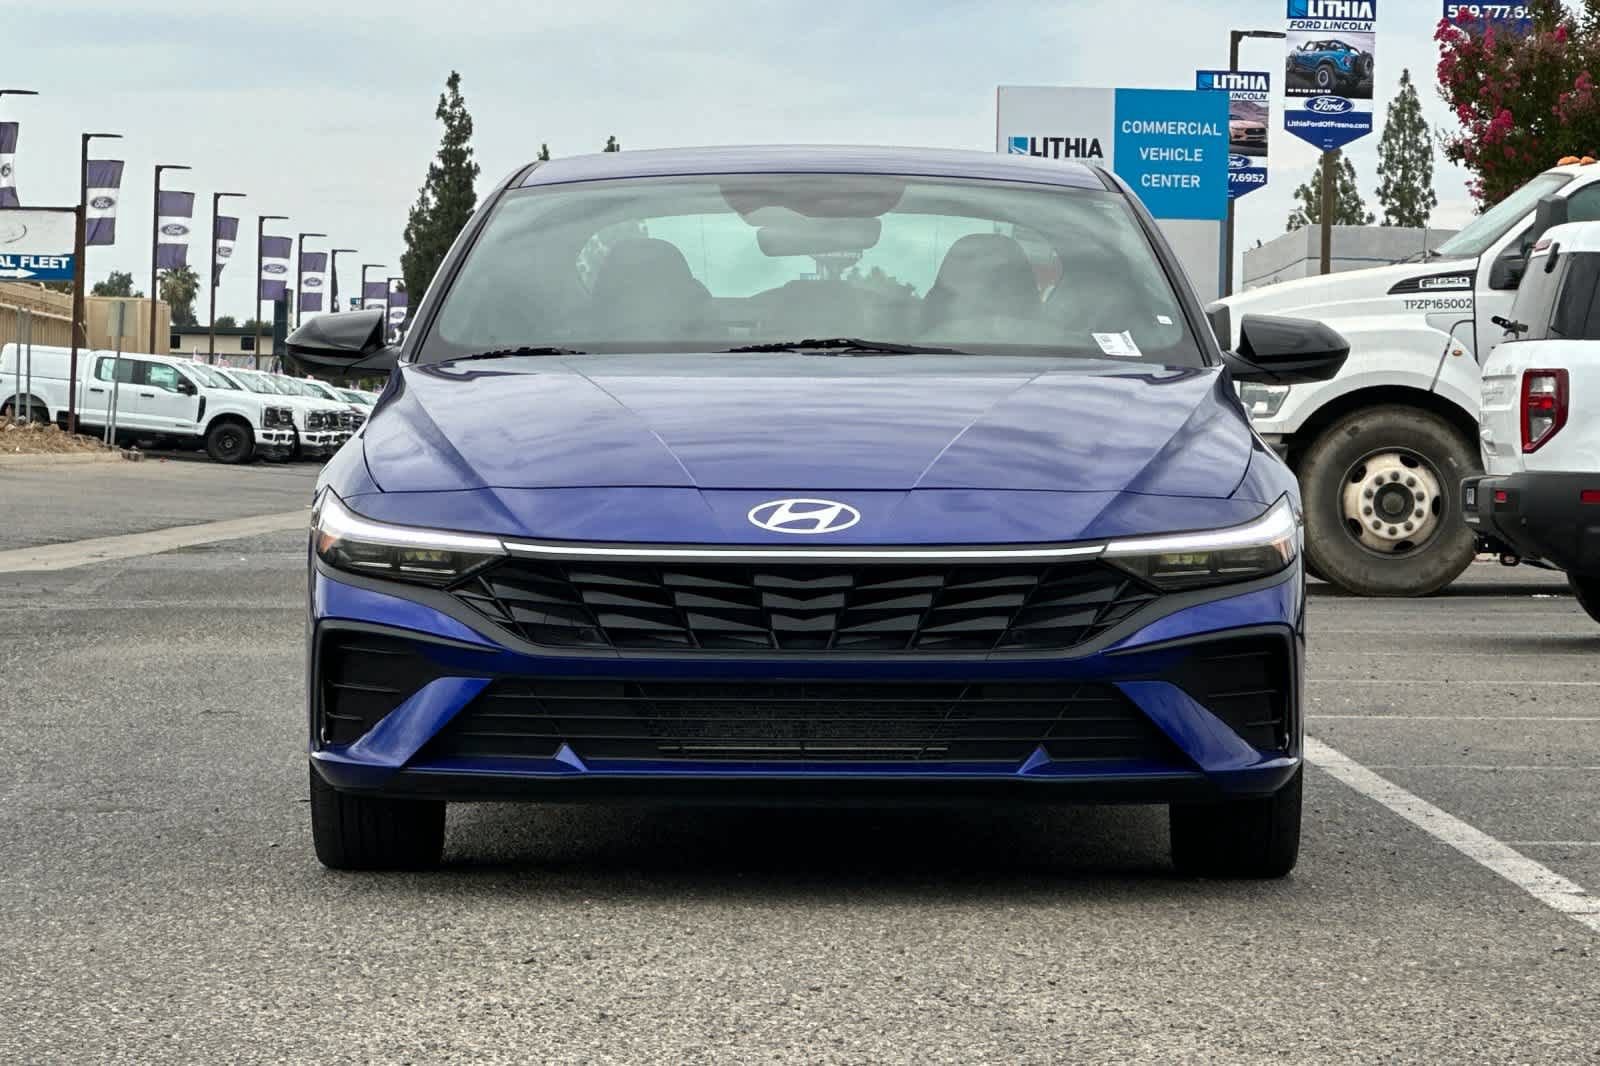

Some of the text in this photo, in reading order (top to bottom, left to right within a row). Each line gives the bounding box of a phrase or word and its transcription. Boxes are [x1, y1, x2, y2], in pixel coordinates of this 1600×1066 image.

[1307, 0, 1373, 19] LITHIA
[1290, 20, 1372, 31] FORD LINCOLN
[1213, 75, 1267, 91] LITHIA
[1230, 92, 1267, 100] INCOLN
[1312, 97, 1345, 111] Ford
[1122, 120, 1222, 137] COMMERCIAL
[1030, 136, 1104, 160] LITHIA
[1139, 147, 1203, 162] VEHICLE
[1140, 174, 1201, 189] CENTER
[20, 255, 70, 270] FLEET
[1403, 299, 1473, 310] TPZP165002
